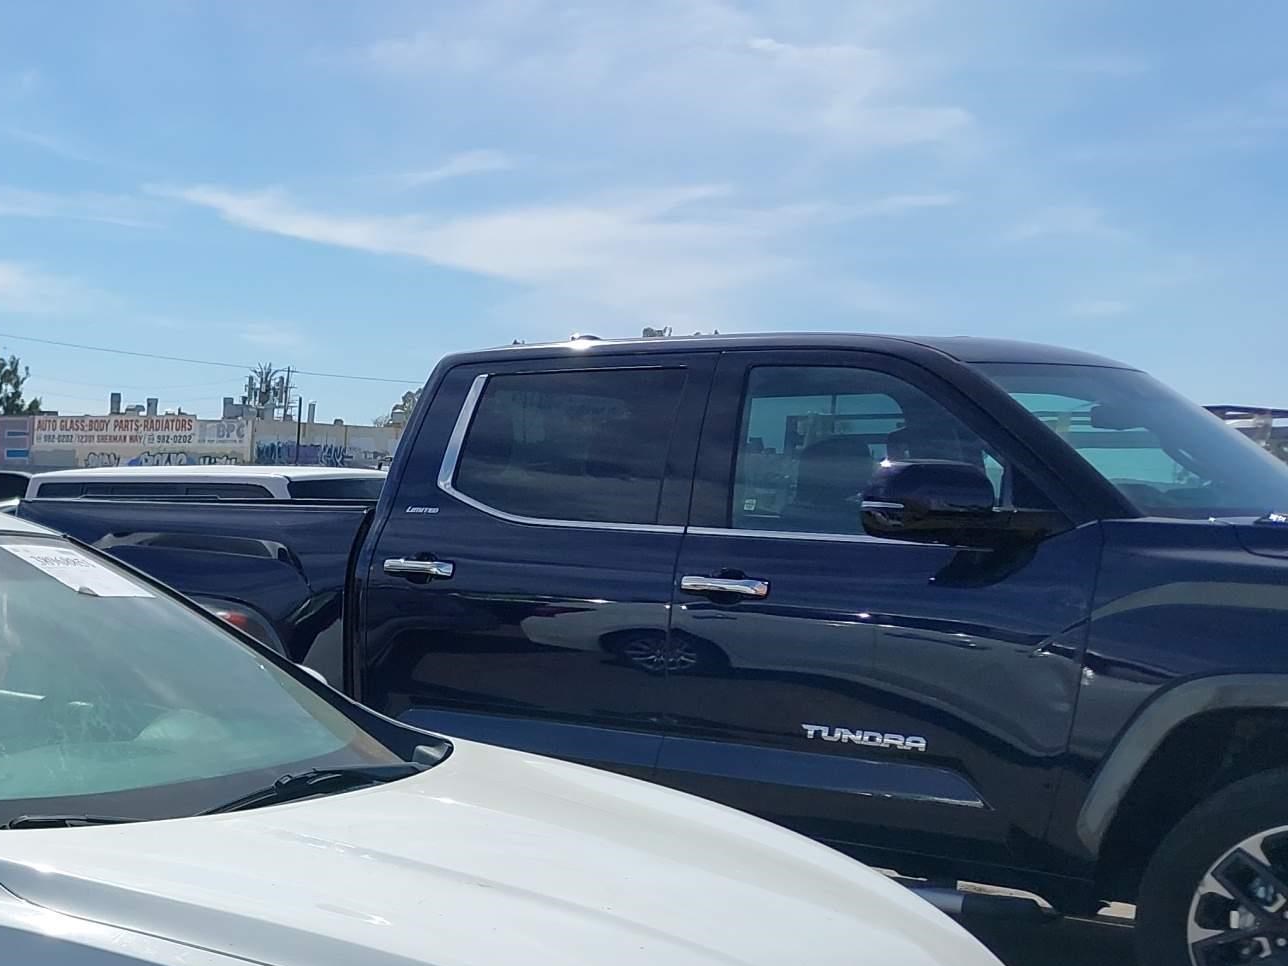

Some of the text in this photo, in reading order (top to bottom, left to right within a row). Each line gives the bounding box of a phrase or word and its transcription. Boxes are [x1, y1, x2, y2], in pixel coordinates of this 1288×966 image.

[36, 419, 57, 432] AUTO
[156, 433, 193, 444] 982-0202
[800, 723, 928, 752] TUNDRA
